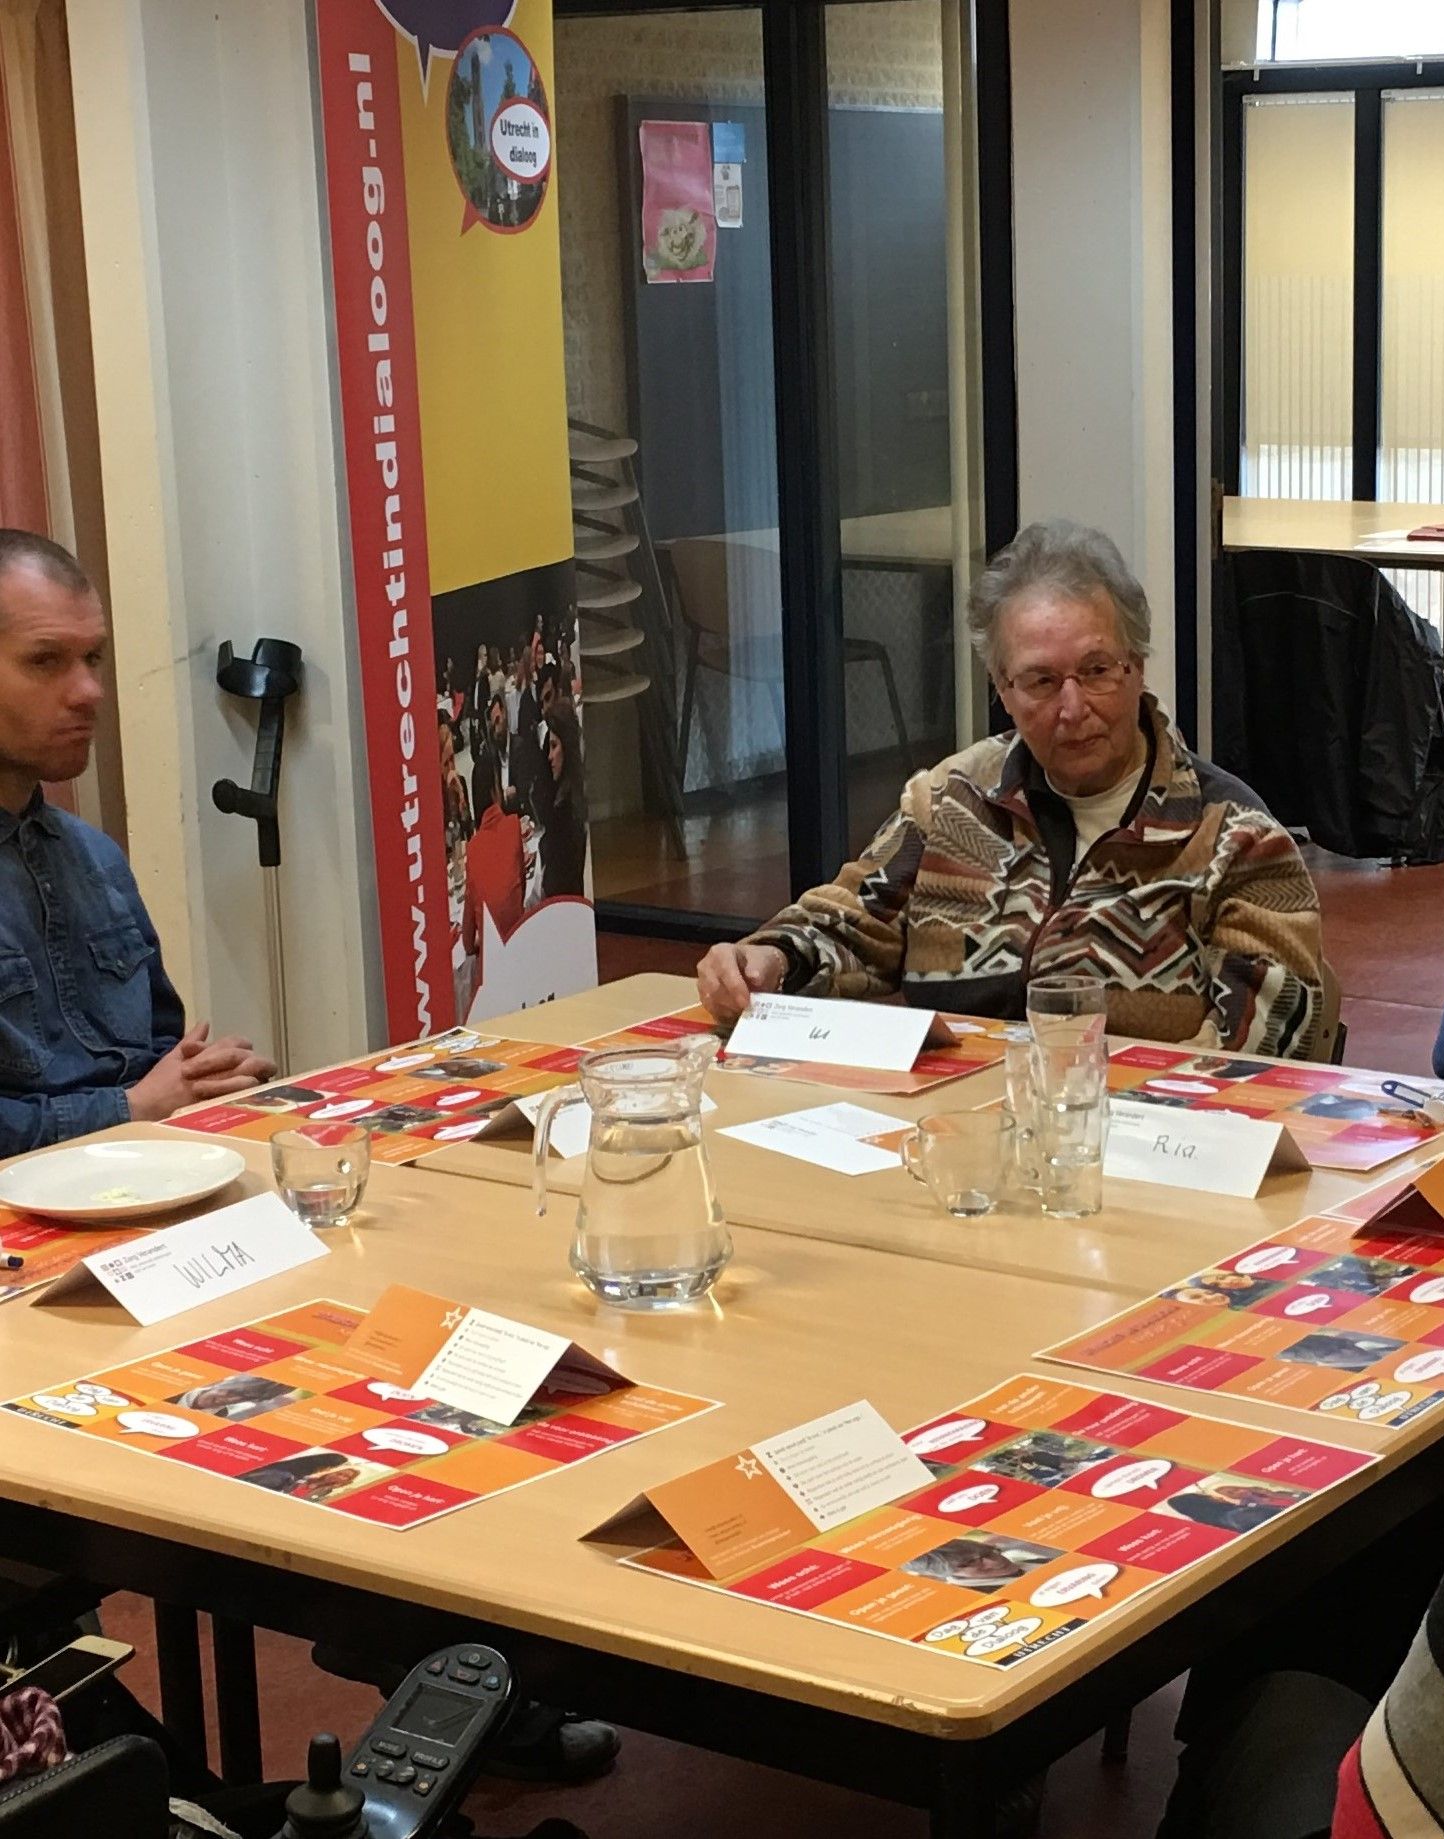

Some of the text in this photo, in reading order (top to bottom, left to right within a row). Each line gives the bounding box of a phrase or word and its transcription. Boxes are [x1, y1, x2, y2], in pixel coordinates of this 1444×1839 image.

[499, 118, 539, 138] Utrecht in
[509, 146, 537, 168] dialoog
[172, 1240, 255, 1288] WILMA
[932, 1624, 962, 1639] Dag
[981, 1624, 1031, 1650] Dialoog
